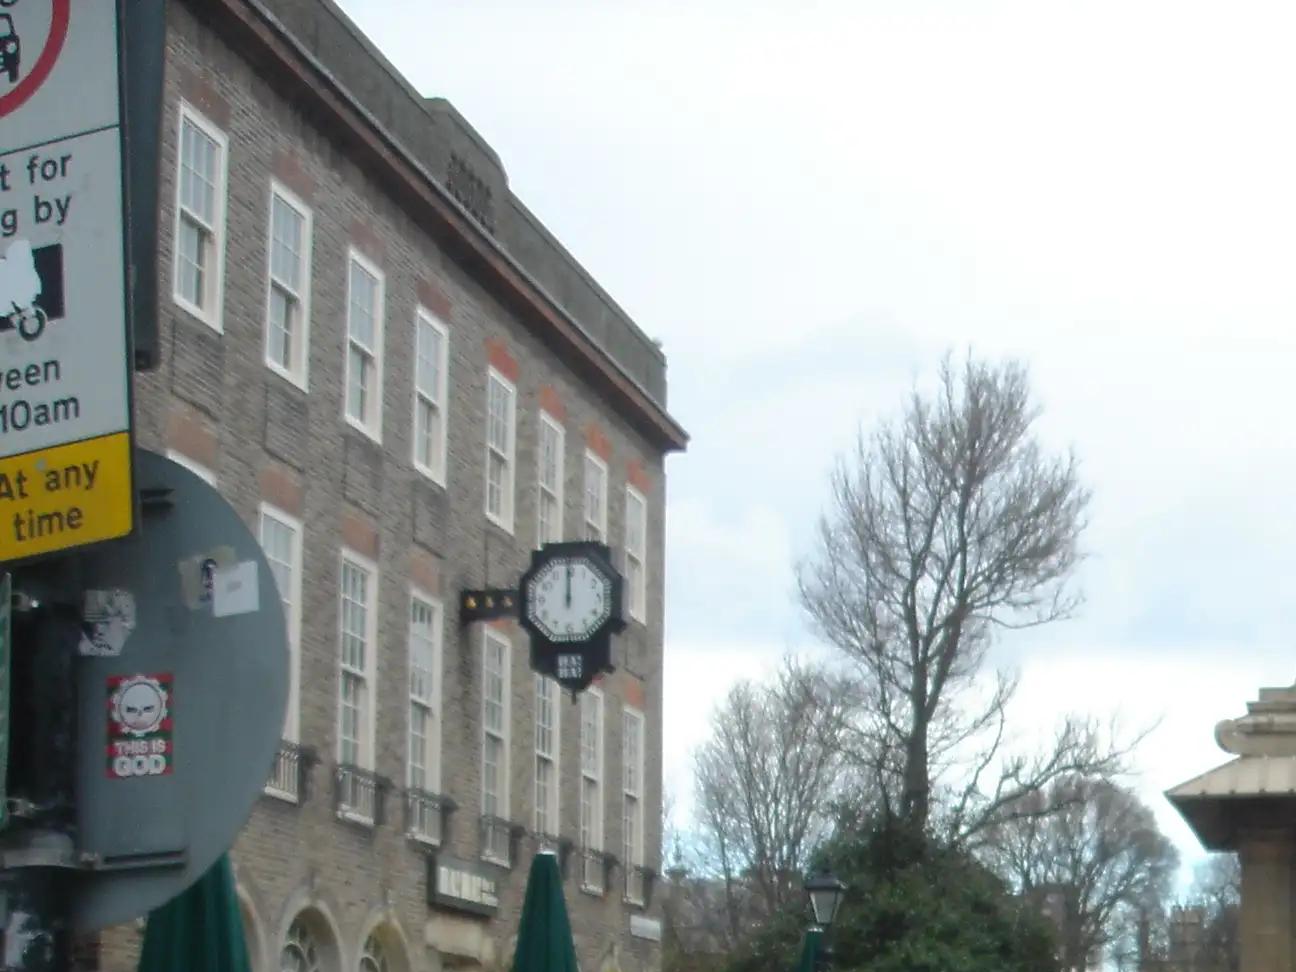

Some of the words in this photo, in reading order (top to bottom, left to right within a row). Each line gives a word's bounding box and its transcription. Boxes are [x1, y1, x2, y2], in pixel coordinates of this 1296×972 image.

[26, 154, 72, 184] for
[34, 195, 71, 225] by
[0, 469, 28, 500] At
[45, 460, 99, 492] any
[14, 507, 83, 541] time
